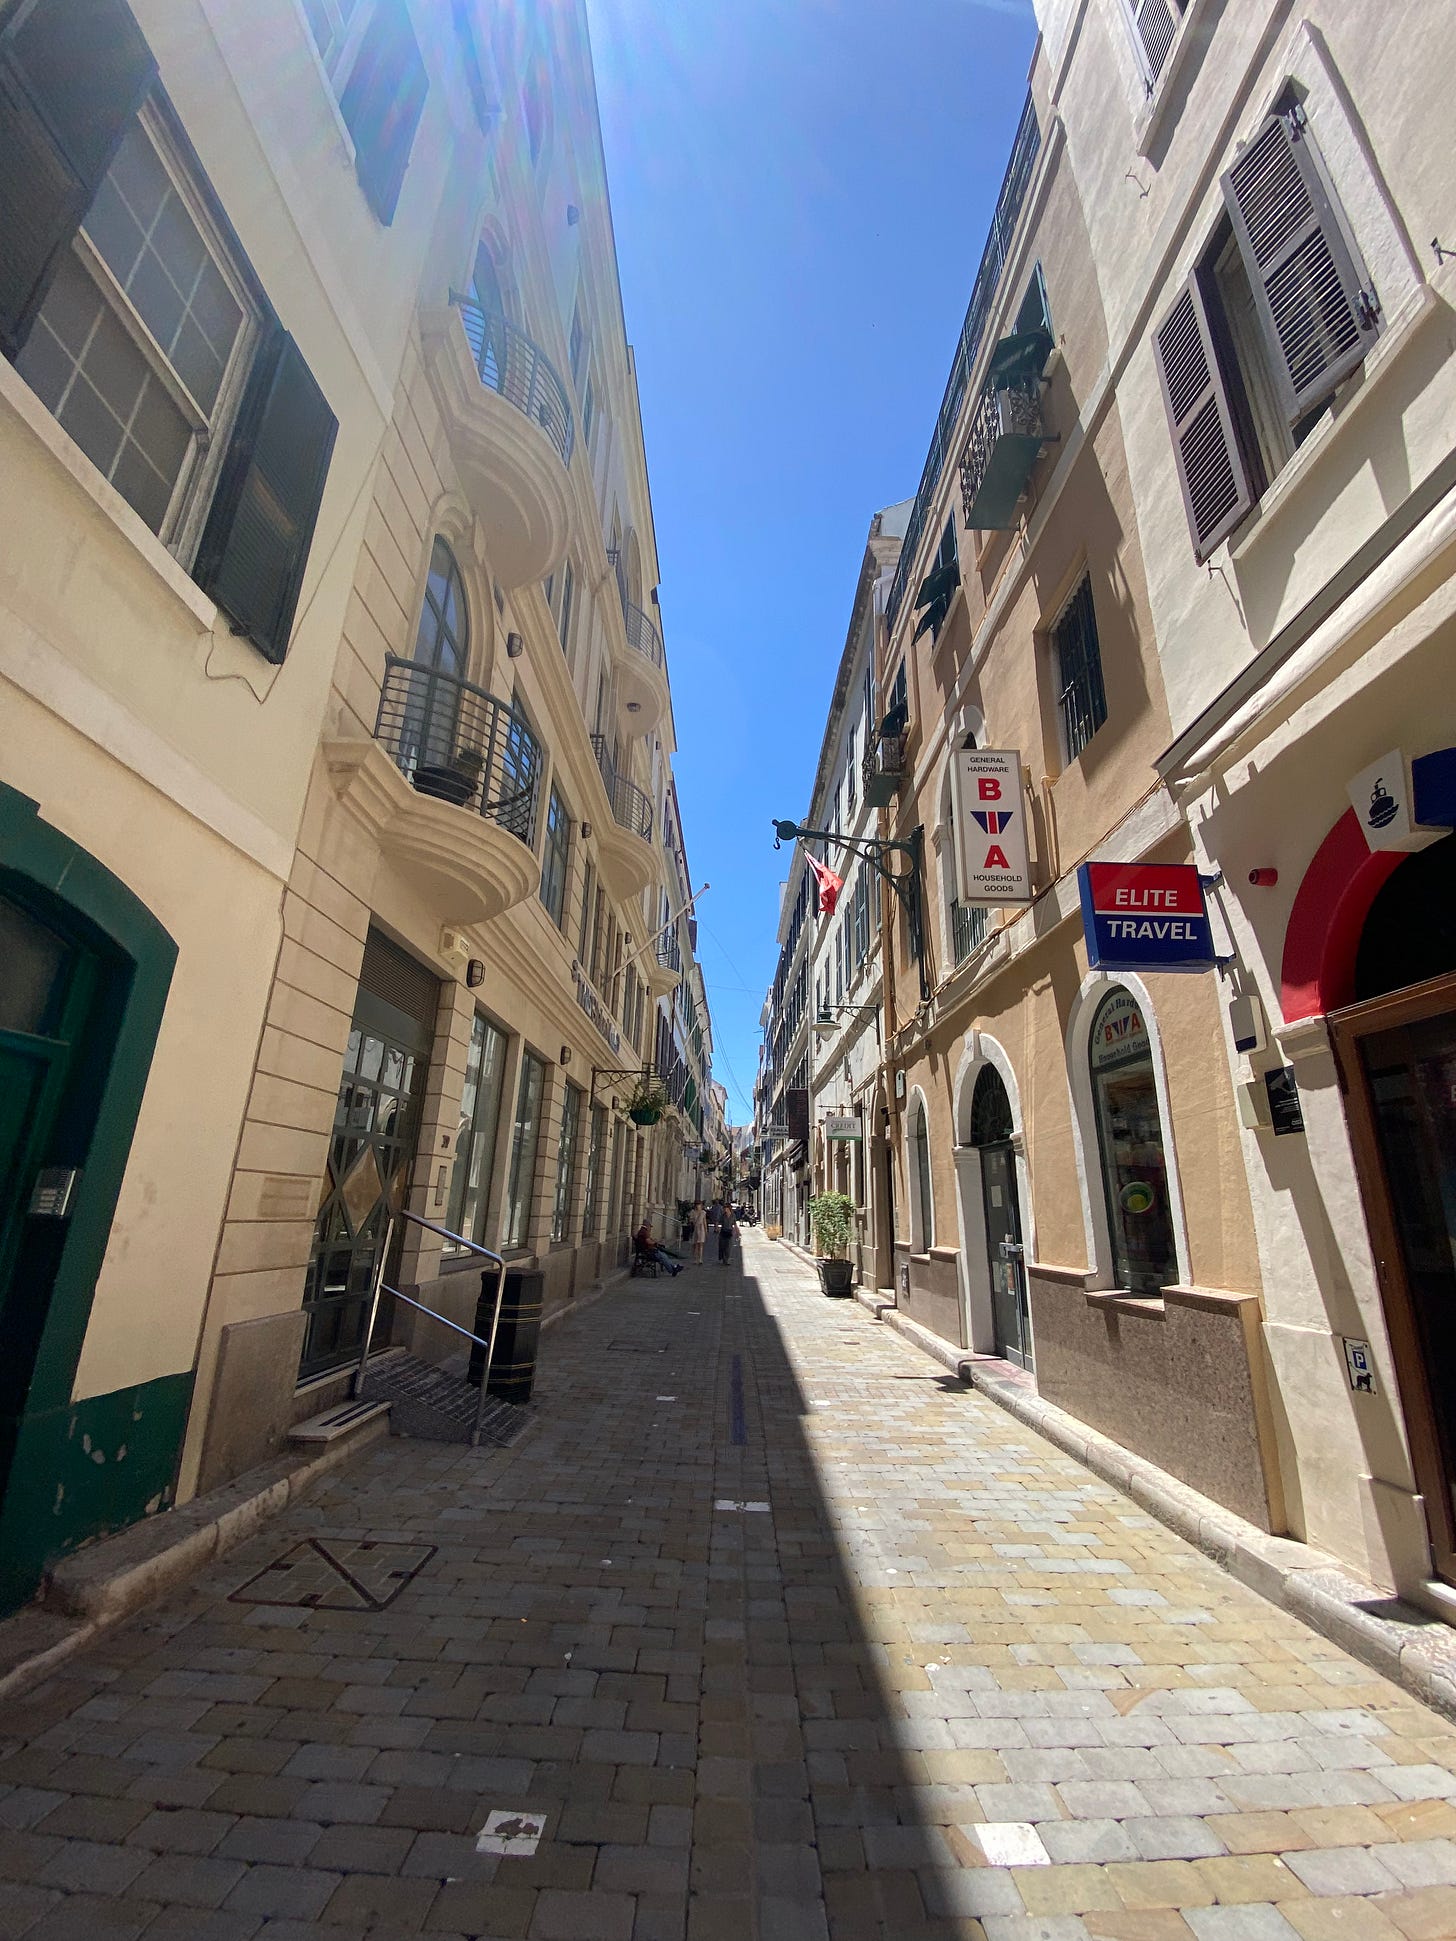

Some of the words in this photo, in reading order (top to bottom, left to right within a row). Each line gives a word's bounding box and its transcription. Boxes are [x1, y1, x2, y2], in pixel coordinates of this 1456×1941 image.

[970, 756, 1005, 764] GENERAL
[973, 874, 1023, 882] HOUSEHOLD
[1115, 888, 1178, 907] ELITE
[1106, 920, 1198, 940] TRAVEL
[1095, 1003, 1115, 1045] General
[1098, 1043, 1132, 1063] Household
[1355, 1353, 1364, 1367] P
